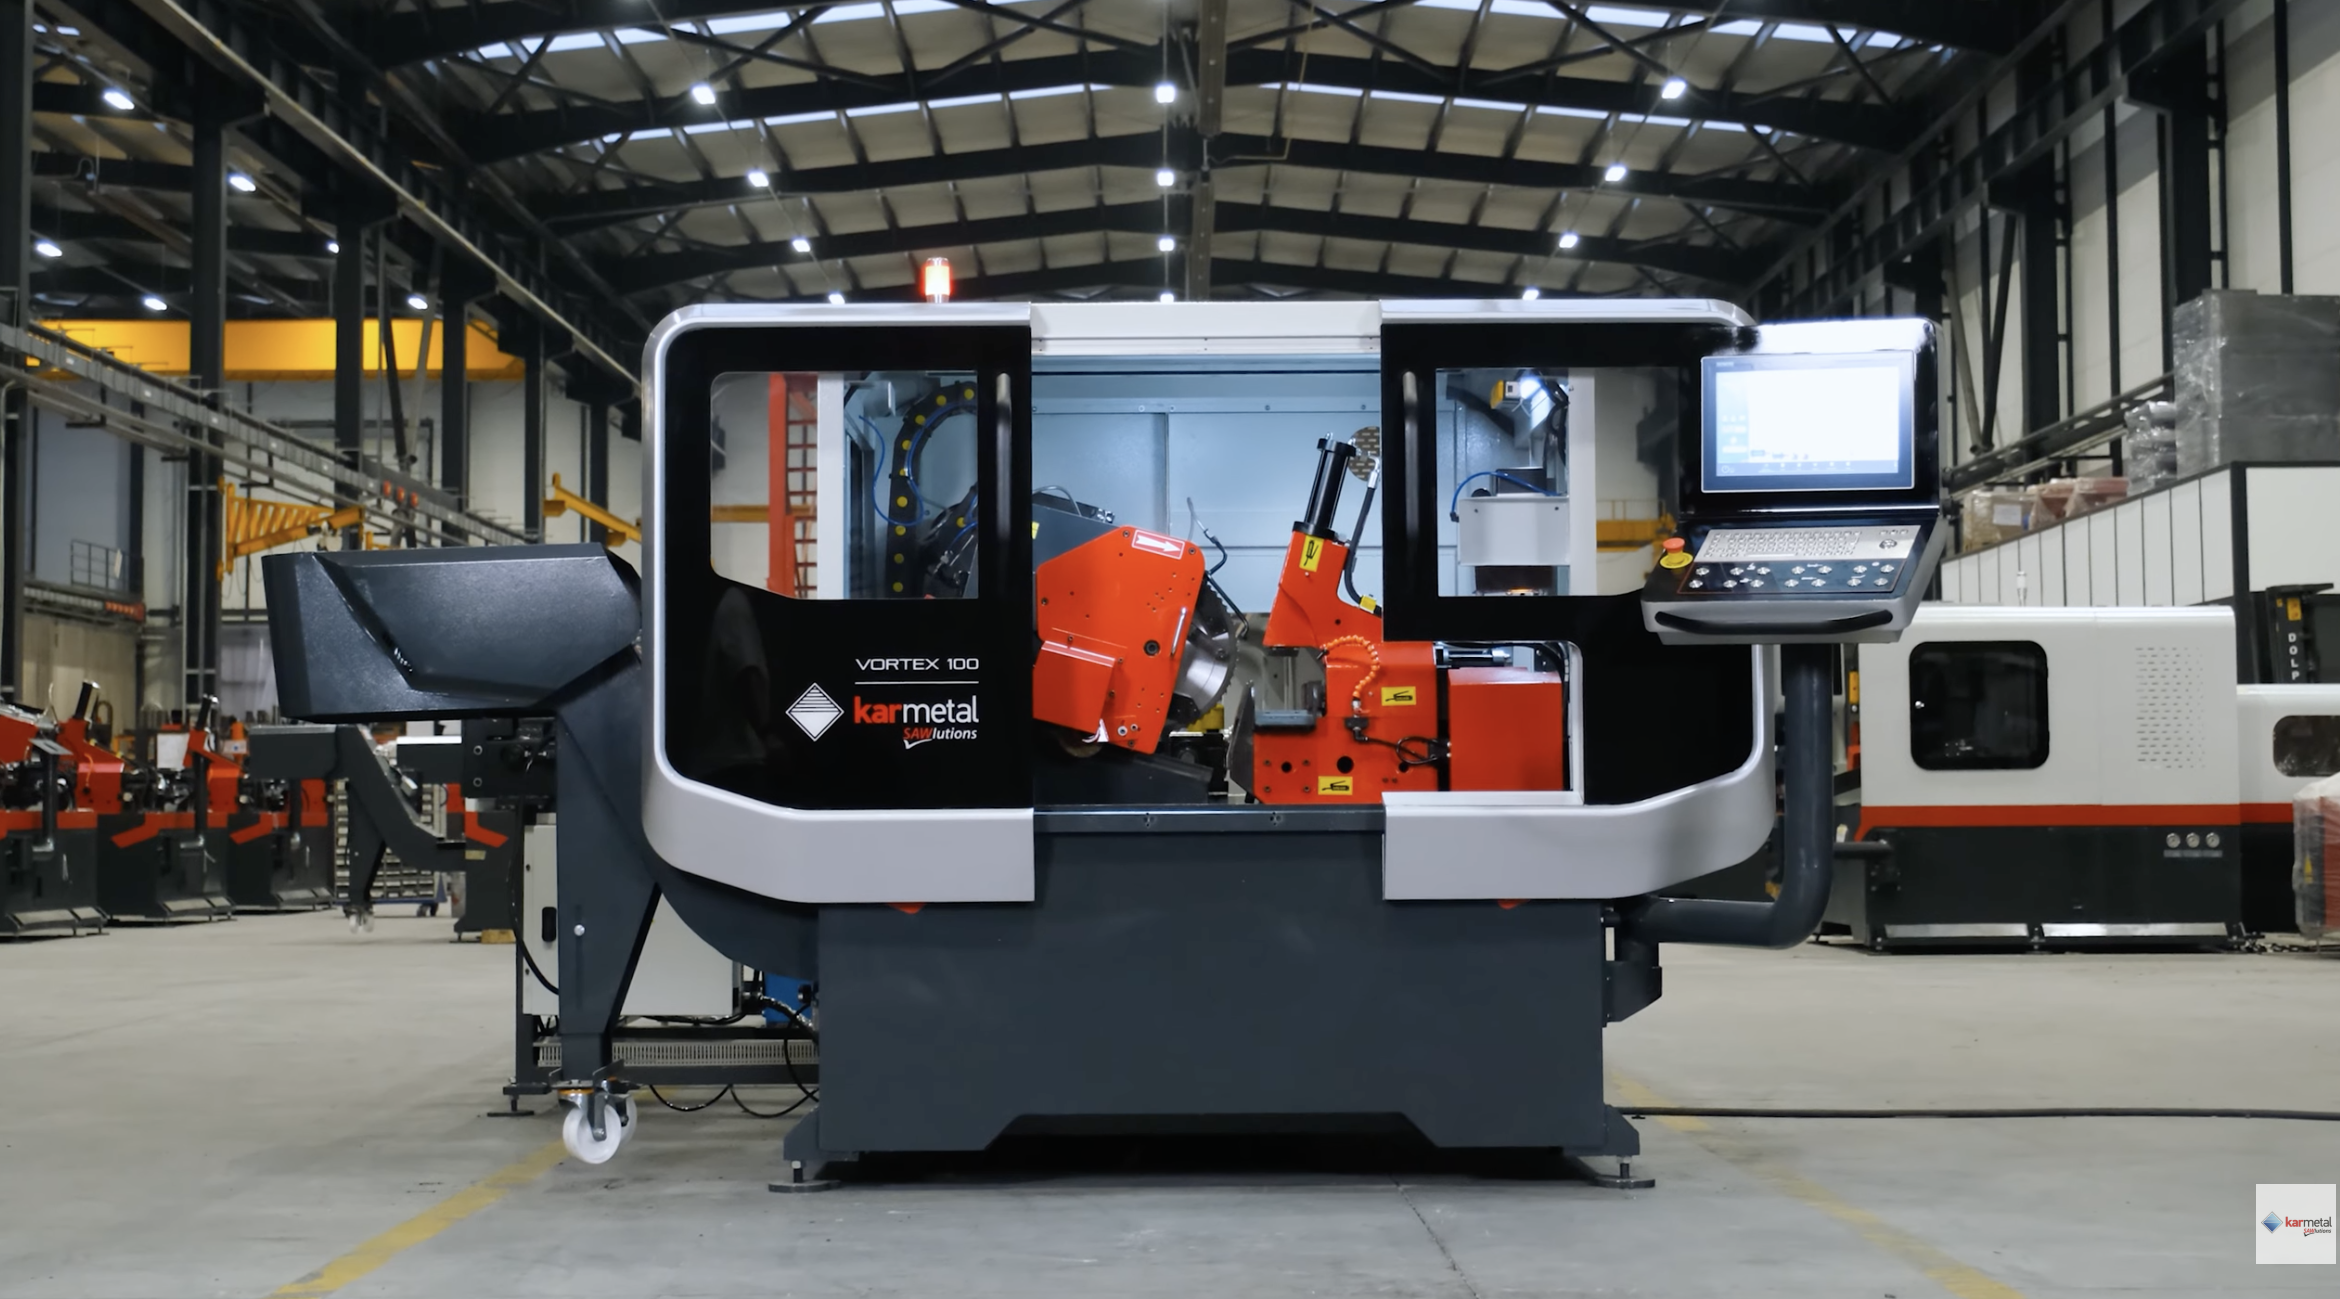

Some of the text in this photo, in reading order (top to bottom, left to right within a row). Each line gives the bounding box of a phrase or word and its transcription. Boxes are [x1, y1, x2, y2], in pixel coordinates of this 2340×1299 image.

[855, 658, 979, 670] VORTEX 100
[854, 695, 979, 723] karmetal
[903, 727, 977, 740] SAWlutions
